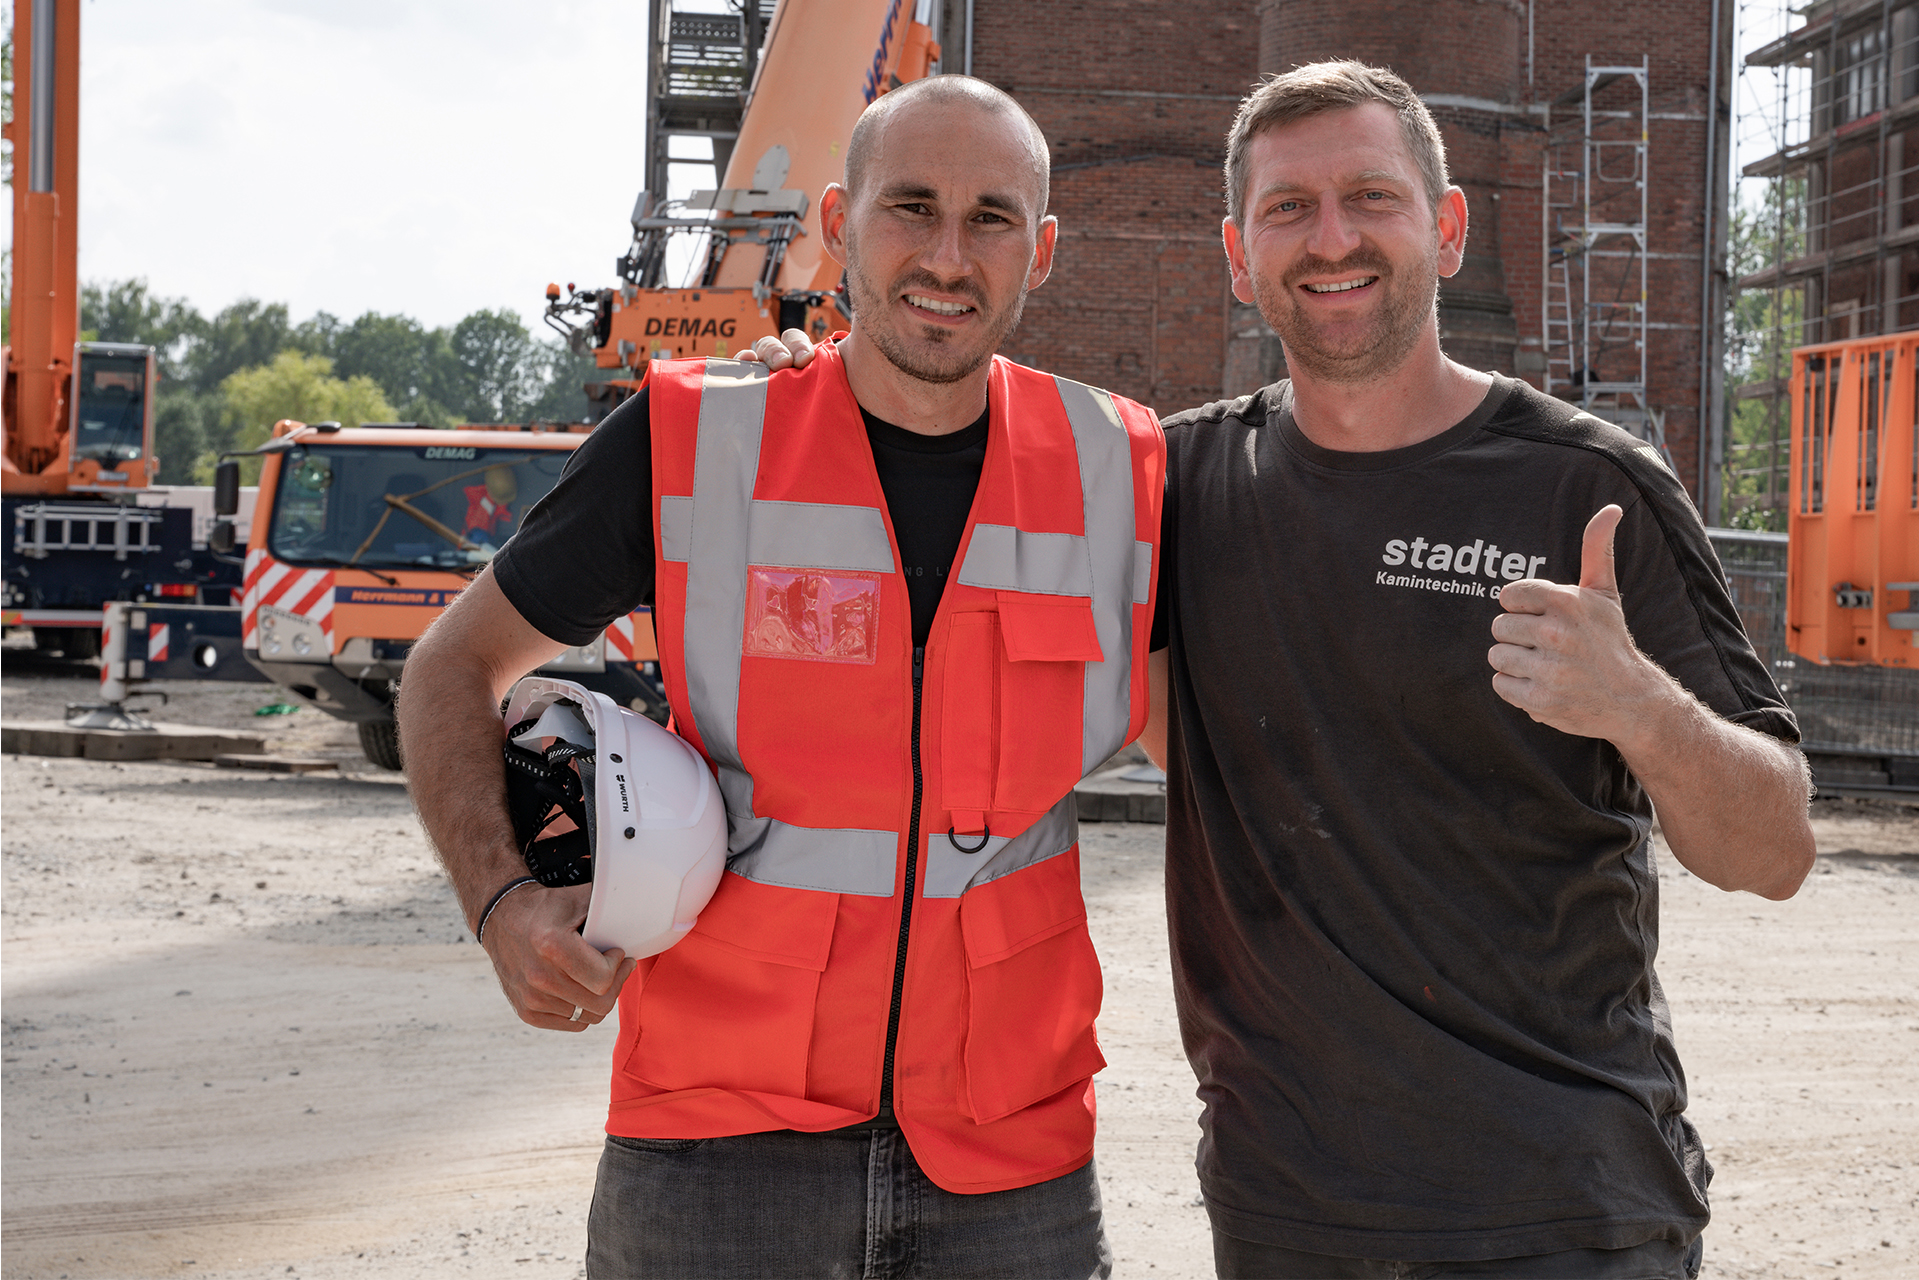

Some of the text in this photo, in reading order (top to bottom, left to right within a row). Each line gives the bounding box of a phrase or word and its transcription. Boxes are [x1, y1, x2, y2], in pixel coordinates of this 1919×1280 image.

[644, 317, 737, 338] DEMAG
[425, 446, 477, 460] DEMAG
[1382, 536, 1547, 581] stadter
[1375, 570, 1506, 600] Kamintechnik G
